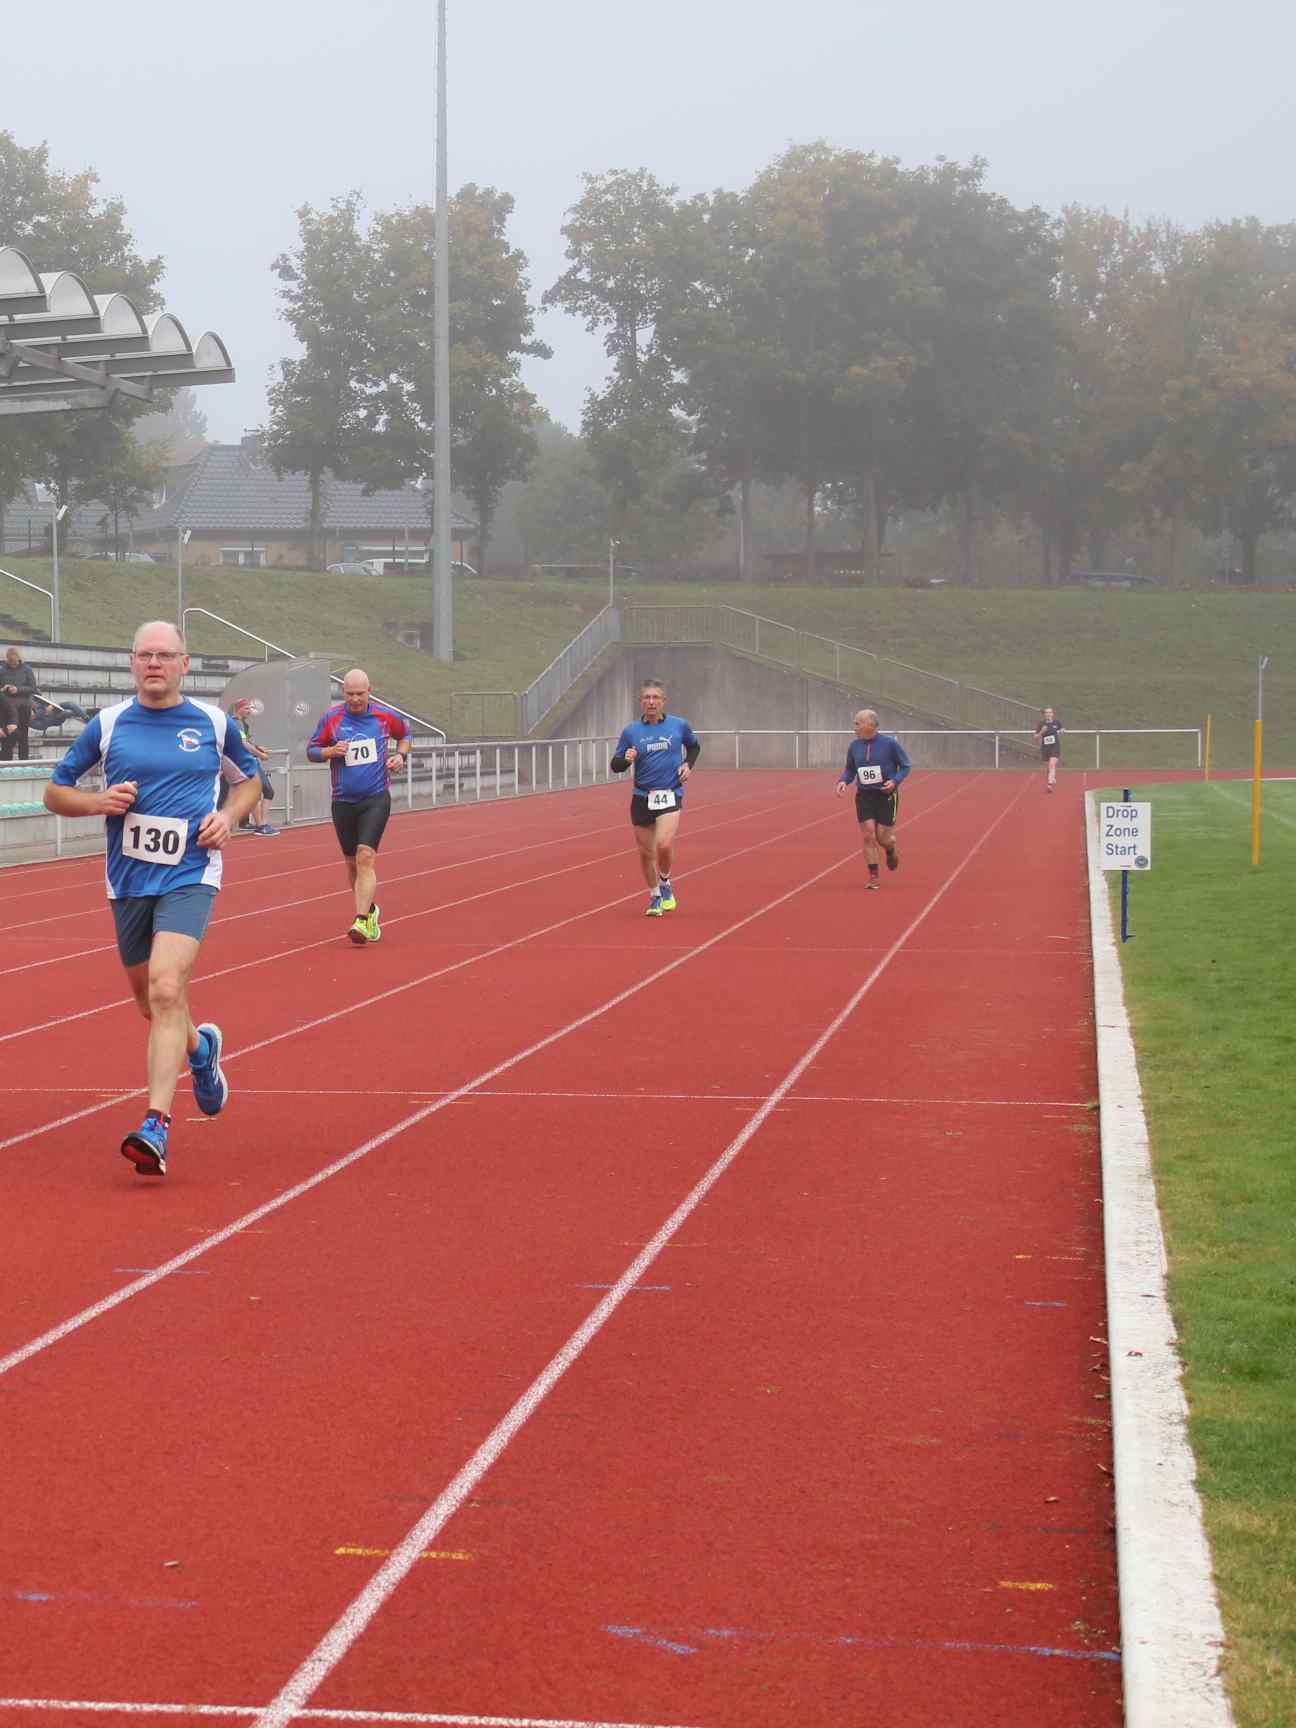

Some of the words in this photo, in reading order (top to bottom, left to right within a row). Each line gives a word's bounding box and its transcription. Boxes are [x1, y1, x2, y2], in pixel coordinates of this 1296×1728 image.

[351, 746, 370, 761] 70
[863, 769, 876, 780] 96
[653, 793, 669, 805] 44
[1106, 806, 1138, 821] Drop
[1105, 824, 1139, 838] Zone
[129, 825, 181, 855] 130
[1105, 843, 1137, 856] Start
